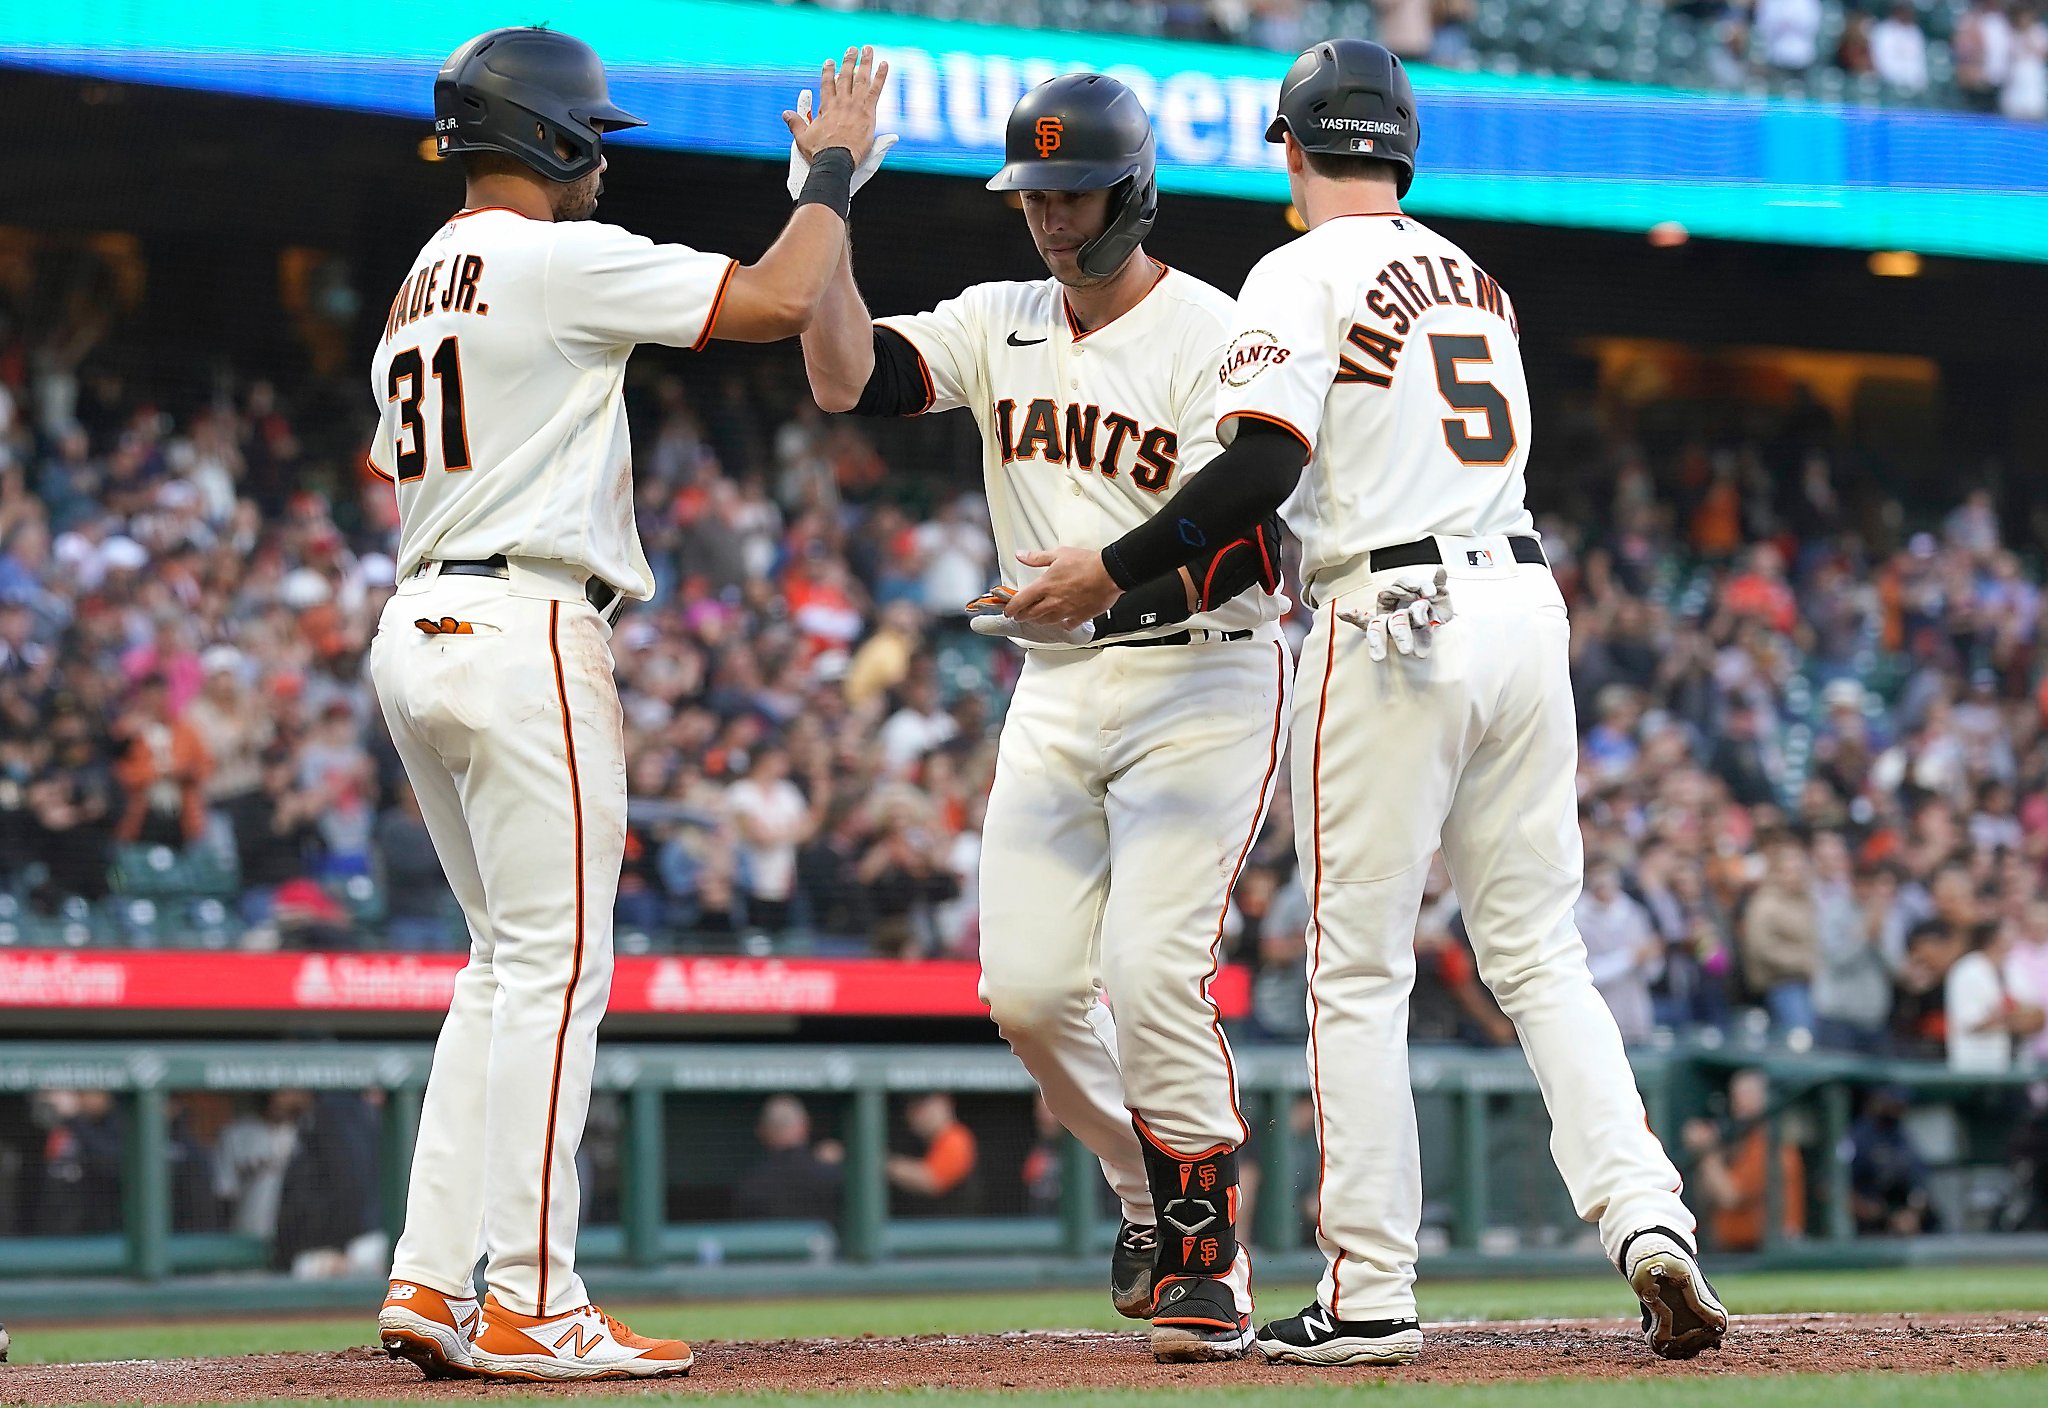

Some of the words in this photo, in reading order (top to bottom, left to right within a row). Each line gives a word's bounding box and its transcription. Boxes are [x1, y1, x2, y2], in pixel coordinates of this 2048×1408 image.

[446, 117, 459, 130] JR.
[1035, 116, 1063, 158] SF
[1320, 118, 1400, 135] YASTRZEMSKI
[441, 253, 489, 316] JR.
[1219, 345, 1291, 384] GIANTS
[388, 335, 472, 484] 31
[1427, 333, 1517, 467] 5
[993, 398, 1178, 495] IANTS
[1198, 1163, 1217, 1191] SF
[1200, 1237, 1219, 1266] SF
[553, 1322, 604, 1358] N
[1302, 1309, 1334, 1341] N
